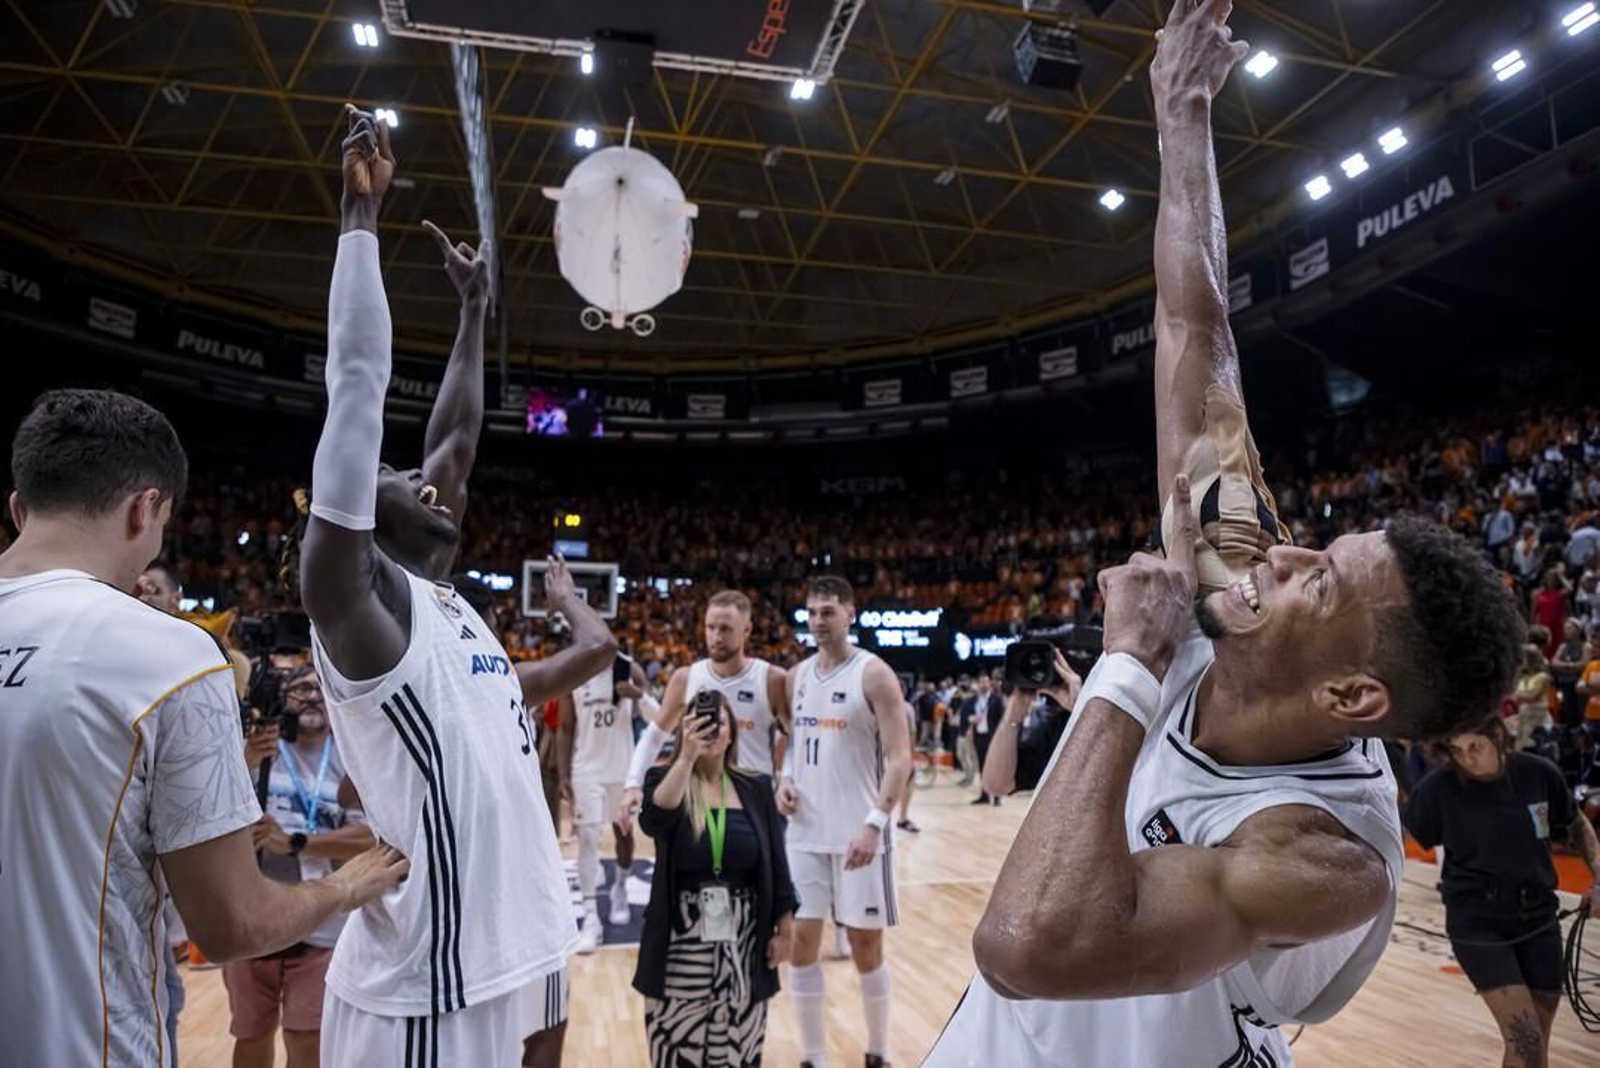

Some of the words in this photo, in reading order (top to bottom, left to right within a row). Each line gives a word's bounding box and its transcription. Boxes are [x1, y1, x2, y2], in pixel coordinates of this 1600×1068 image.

[1357, 176, 1454, 249] PULEVA
[0, 269, 41, 301] EVA
[178, 330, 265, 369] PULEVA
[820, 475, 906, 494] KGM
[594, 710, 615, 728] 20
[805, 736, 820, 766] 11
